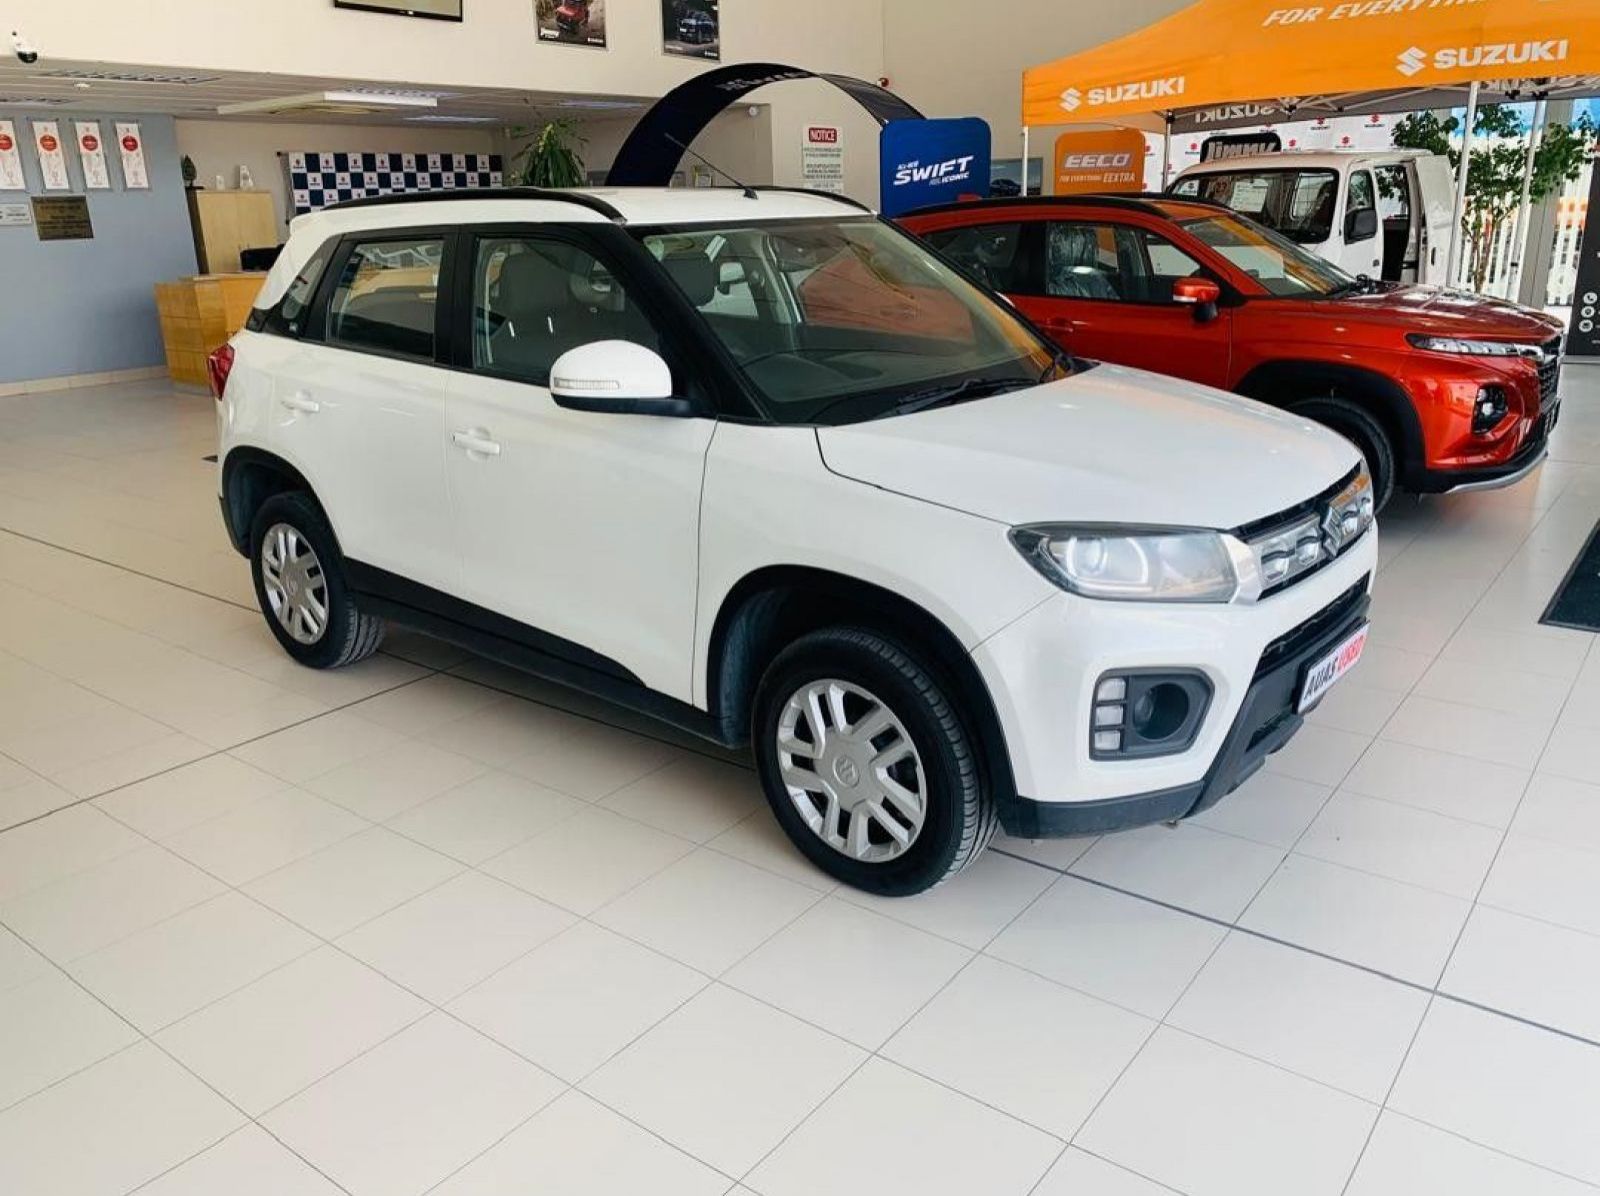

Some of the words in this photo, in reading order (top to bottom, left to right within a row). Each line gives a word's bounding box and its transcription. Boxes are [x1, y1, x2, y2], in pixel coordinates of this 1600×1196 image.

[1262, 7, 1325, 27] FOR
[1433, 39, 1568, 69] SUZUKI
[1087, 76, 1185, 106] SUZUKI
[811, 129, 835, 141] NOTICE
[893, 155, 974, 186] SWIFT
[1064, 153, 1131, 168] EECO
